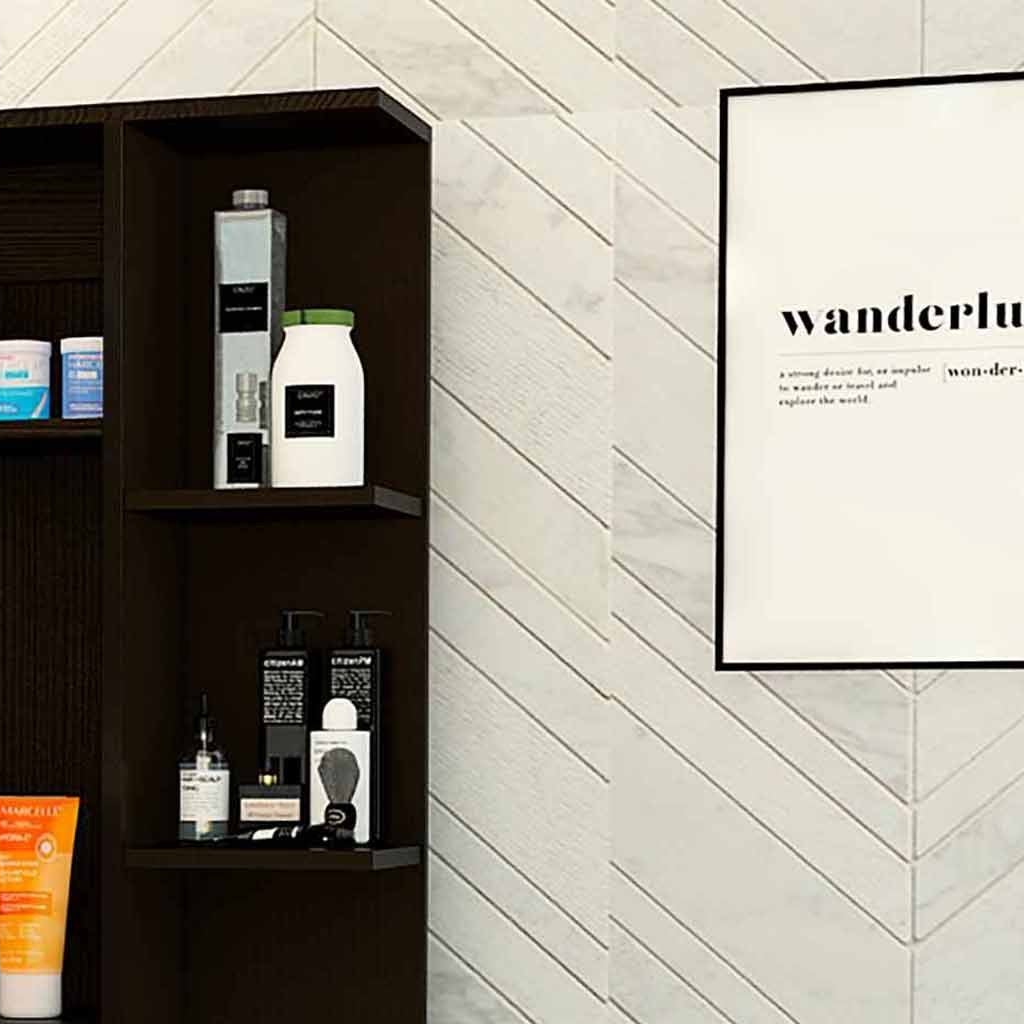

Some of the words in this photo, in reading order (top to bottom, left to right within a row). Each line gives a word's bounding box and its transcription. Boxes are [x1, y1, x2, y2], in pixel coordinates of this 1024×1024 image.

[780, 291, 1023, 336] wanderlu
[788, 369, 820, 380] strong
[823, 367, 853, 377] desire
[792, 381, 829, 392] wander
[878, 379, 897, 389] and
[779, 395, 816, 408] explore
[819, 395, 835, 405] the
